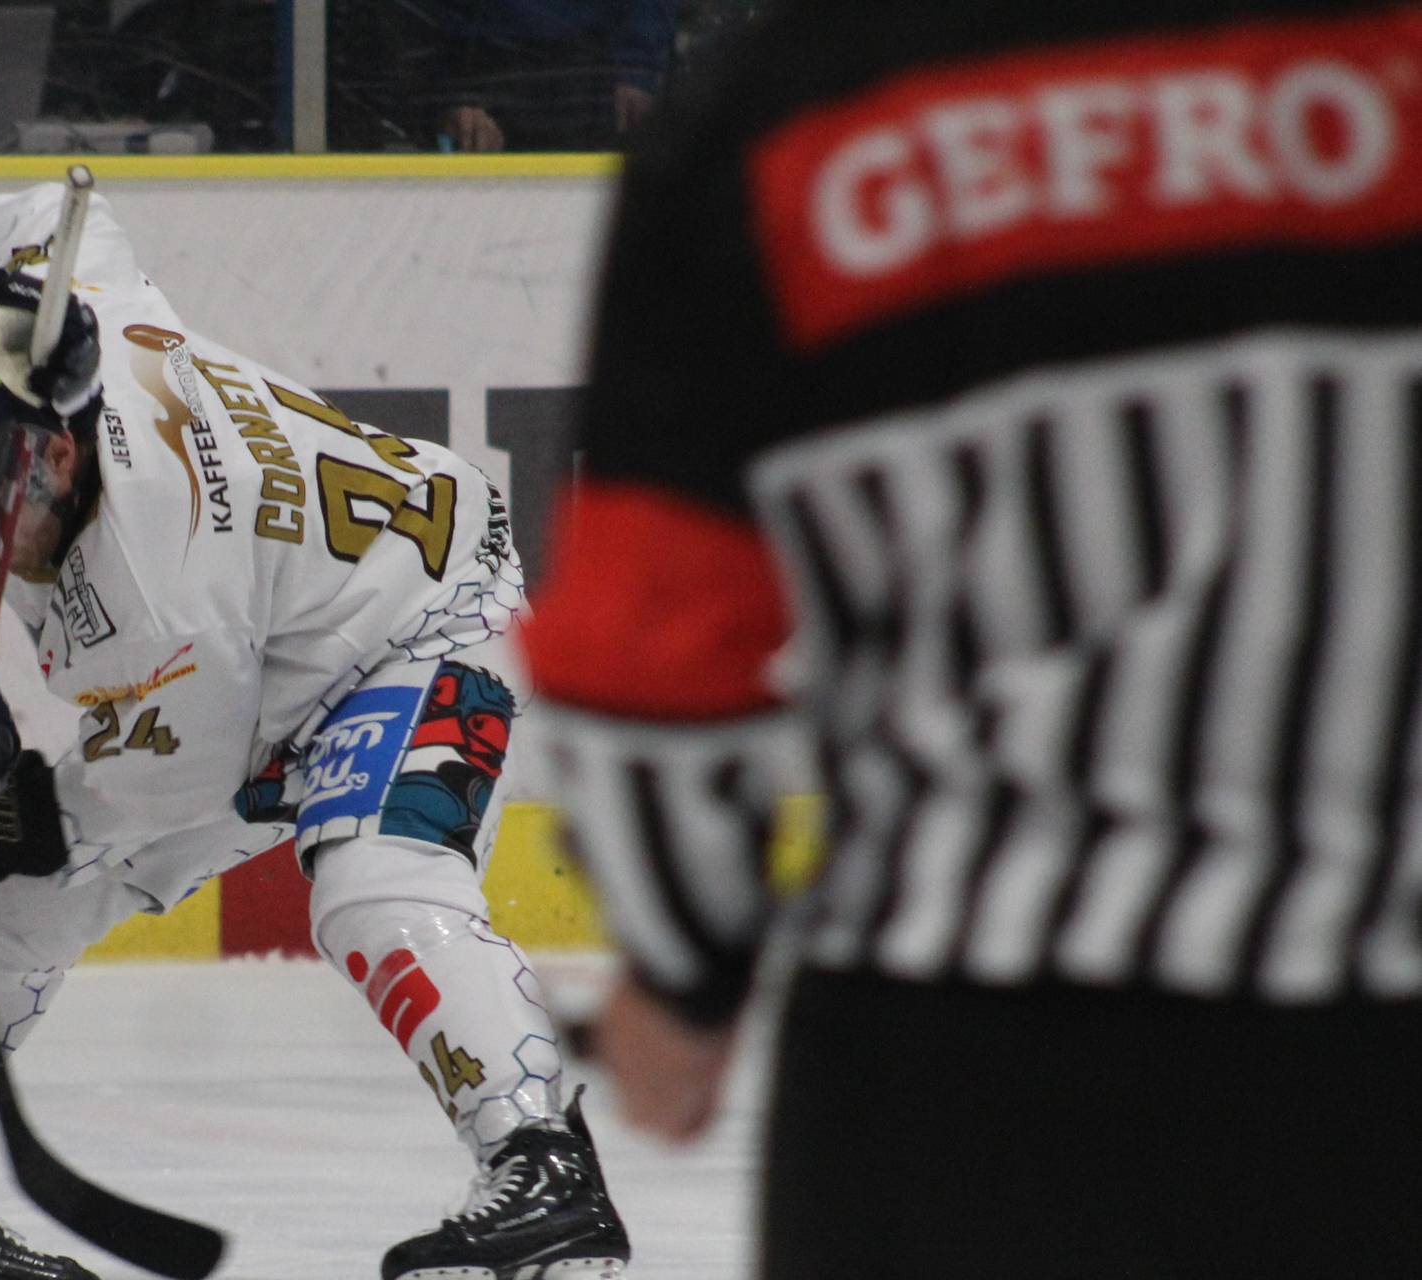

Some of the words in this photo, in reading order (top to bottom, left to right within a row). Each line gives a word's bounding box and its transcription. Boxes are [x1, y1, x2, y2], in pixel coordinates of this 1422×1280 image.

[811, 57, 1396, 278] GEFRO
[189, 352, 307, 545] CORNETT
[83, 699, 181, 763] 24
